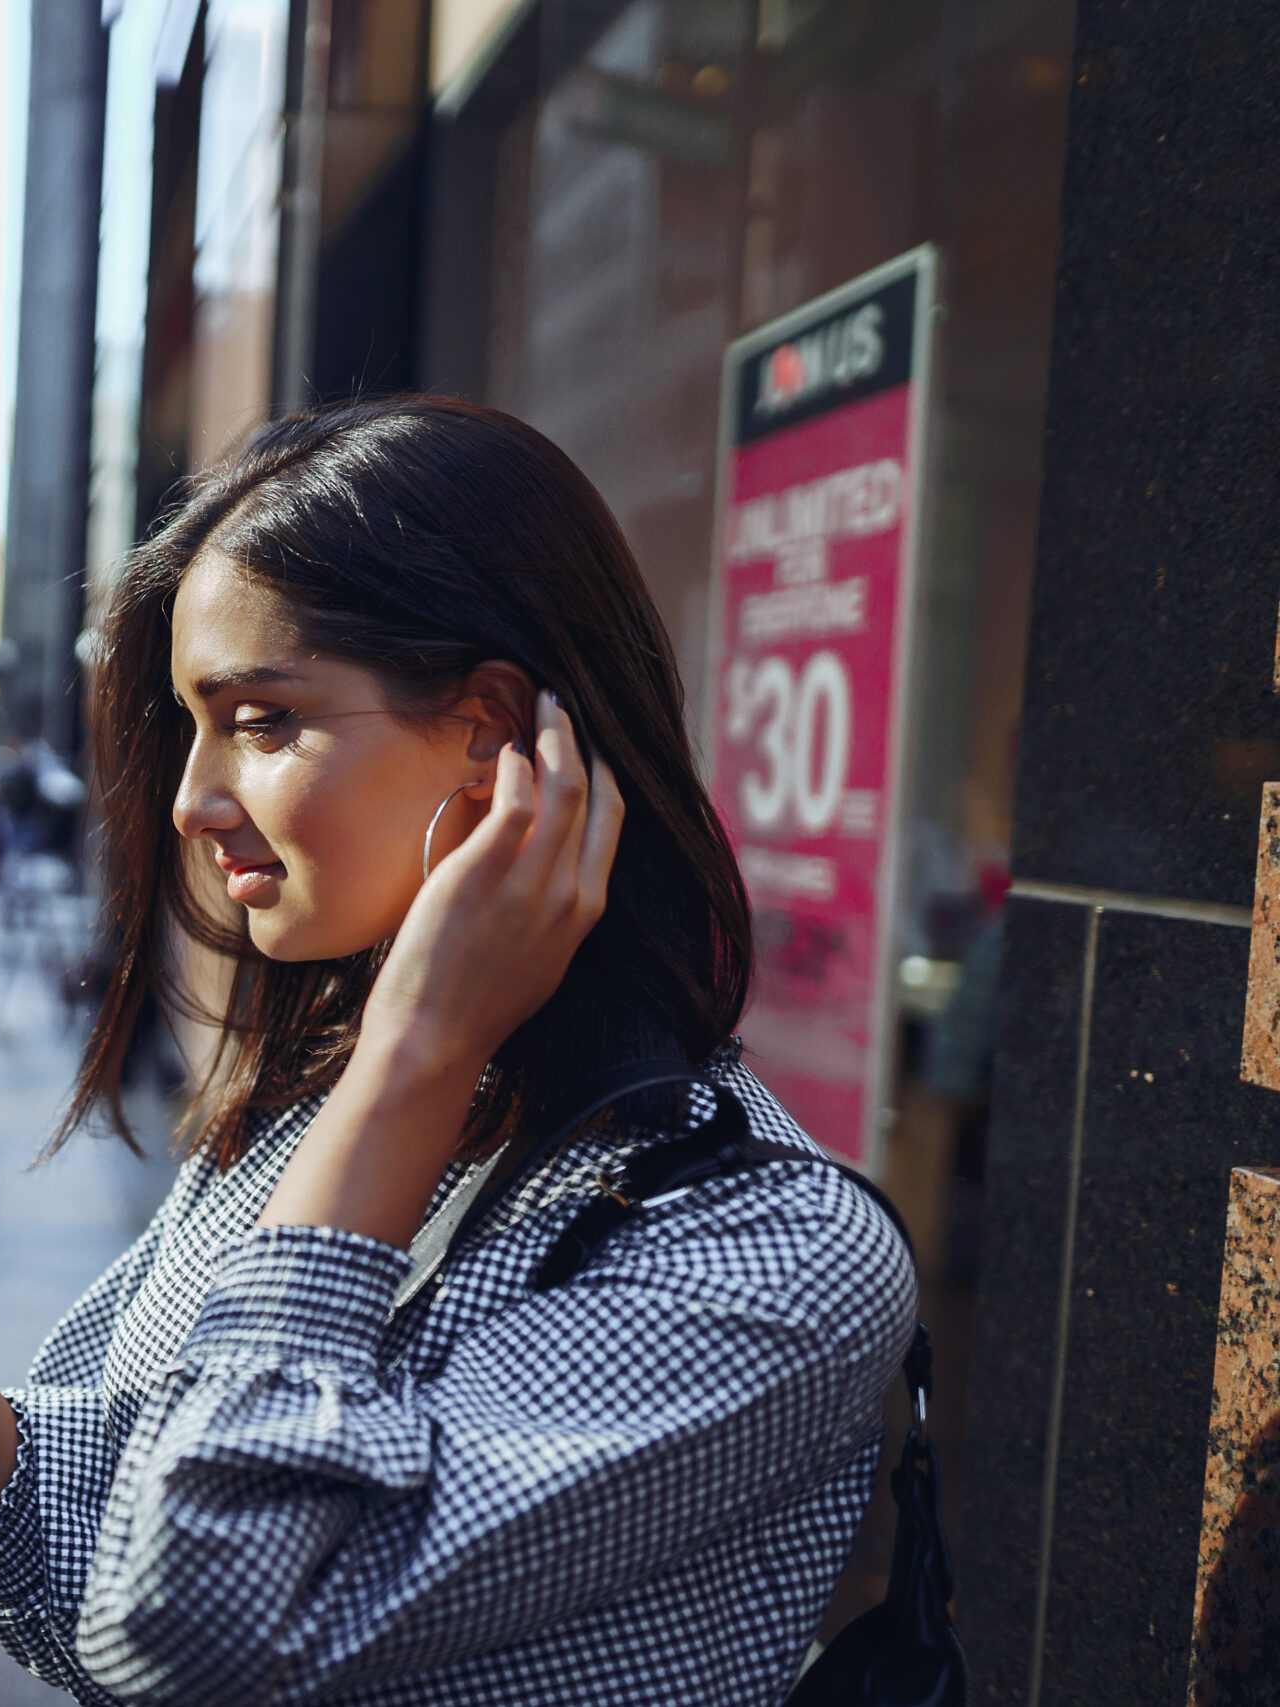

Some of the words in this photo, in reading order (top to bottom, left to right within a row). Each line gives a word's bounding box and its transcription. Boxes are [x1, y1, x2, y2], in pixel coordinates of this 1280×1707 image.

[827, 302, 884, 386] US
[730, 459, 902, 560] UNLIMITED
[727, 652, 848, 826] $30
